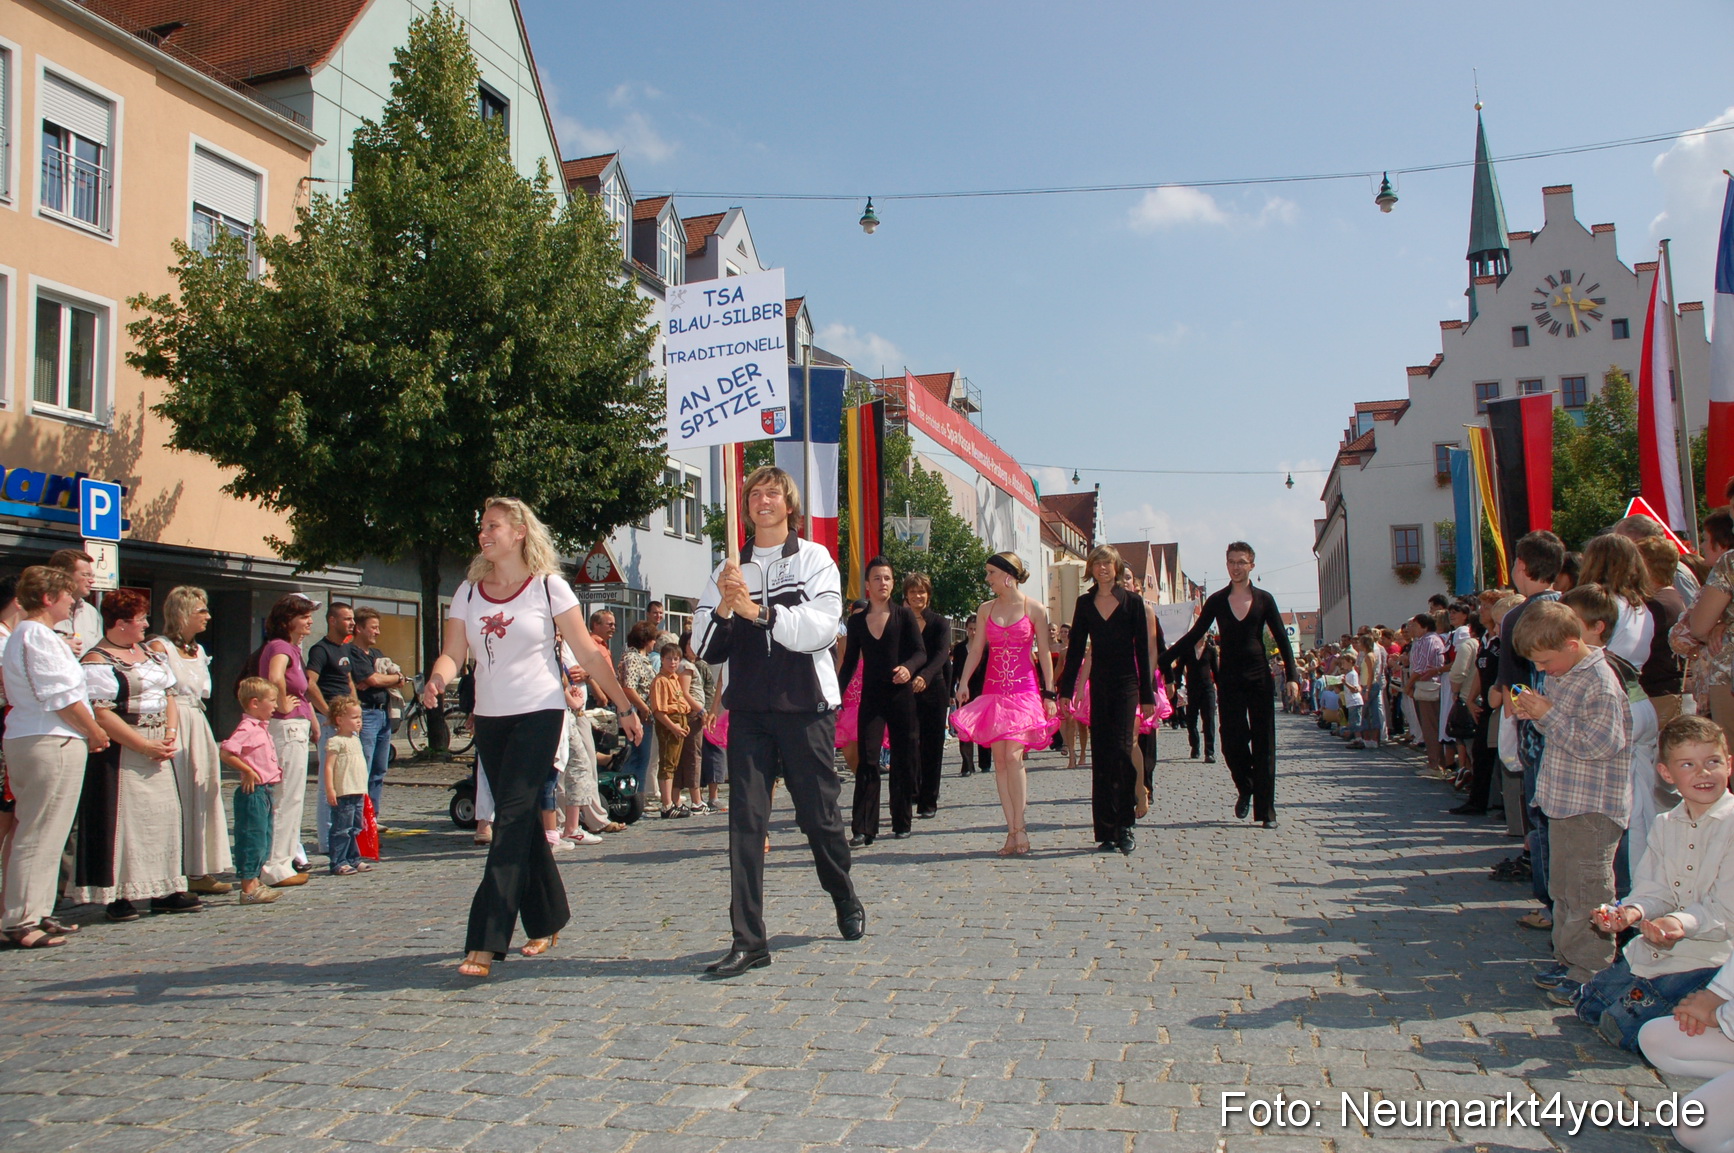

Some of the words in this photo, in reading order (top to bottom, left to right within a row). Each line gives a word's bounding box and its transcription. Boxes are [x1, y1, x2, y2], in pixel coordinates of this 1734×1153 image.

[703, 286, 744, 307] TSA
[669, 303, 783, 334] BLAU-SILBER
[668, 336, 784, 364] TRADITIONELL
[679, 385, 711, 415] AN
[717, 363, 762, 395] DER
[680, 386, 761, 439] SPITZE
[90, 488, 112, 530] P
[578, 591, 618, 601] Nidermayer
